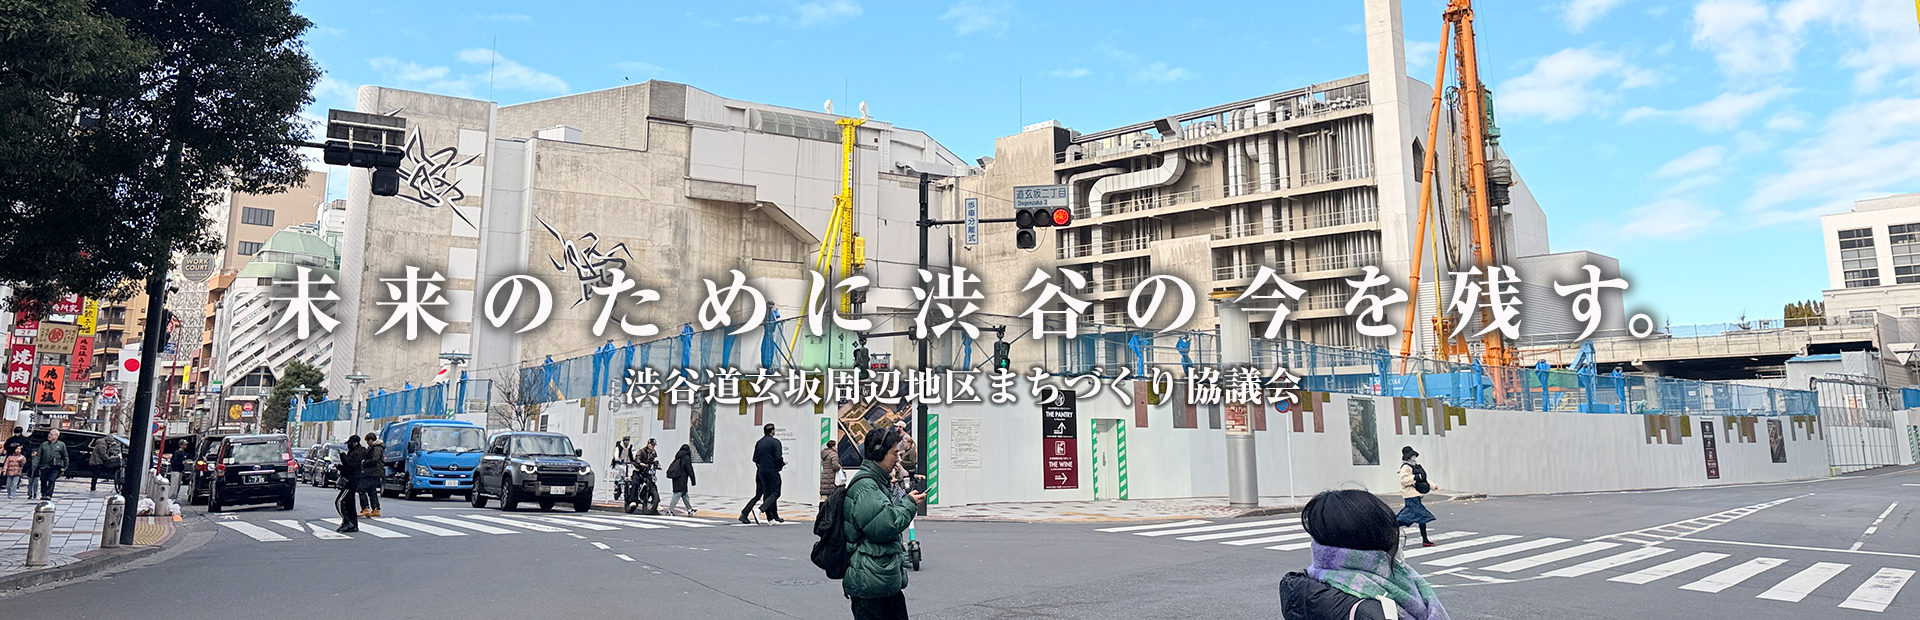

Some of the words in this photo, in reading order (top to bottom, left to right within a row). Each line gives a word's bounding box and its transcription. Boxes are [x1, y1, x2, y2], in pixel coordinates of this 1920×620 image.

[1016, 187, 1066, 200] 道玄坂二丁目
[967, 202, 976, 242] 歩車分離式
[10, 348, 33, 385] 焼肉
[40, 367, 59, 403] 俺流塩
